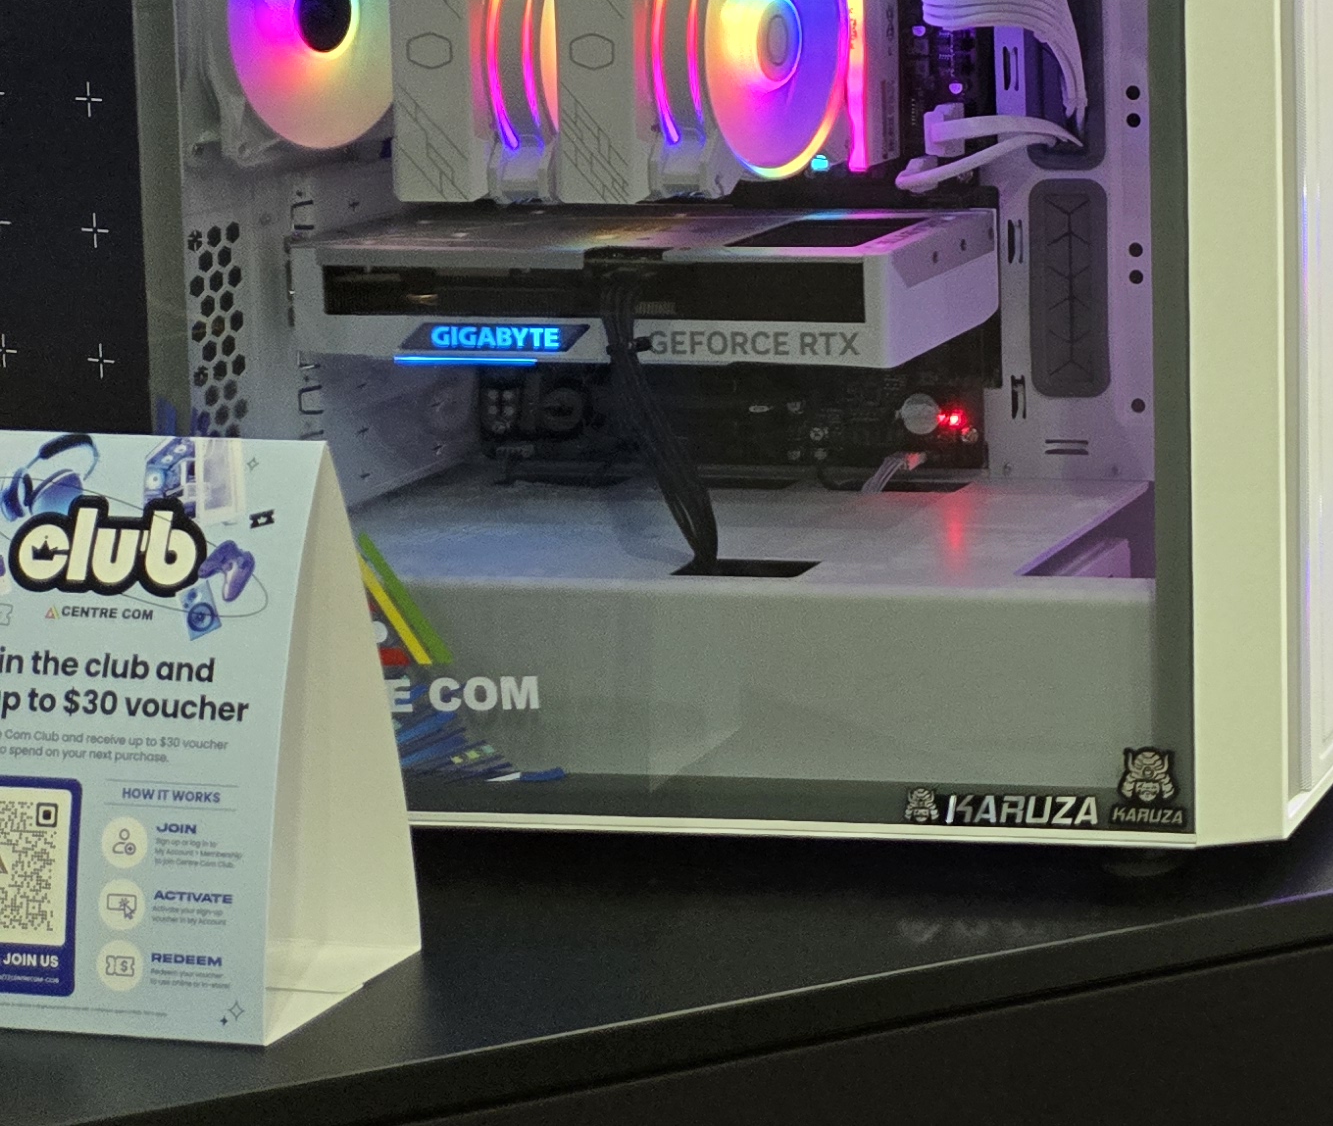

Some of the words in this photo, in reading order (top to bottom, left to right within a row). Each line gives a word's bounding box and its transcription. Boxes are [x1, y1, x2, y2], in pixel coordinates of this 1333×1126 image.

[430, 324, 560, 348] GIGABYTE
[651, 331, 787, 356] GEFORCE
[802, 332, 860, 356] RTX
[18, 506, 198, 587] club
[61, 605, 118, 620] CENTRE
[122, 609, 154, 621] COM
[31, 651, 79, 676] the
[85, 653, 151, 679] club
[156, 657, 216, 683] and
[429, 675, 541, 711] COM
[28, 689, 56, 713] to
[63, 688, 118, 718] $30
[125, 694, 249, 722] voucher
[4, 729, 32, 742] Com
[33, 730, 60, 743] Club
[62, 732, 84, 745] and
[86, 734, 126, 747] receive
[128, 736, 143, 751] up
[145, 736, 157, 748] to
[160, 735, 180, 749] $30
[182, 737, 228, 751] voucher
[9, 744, 43, 758] spend
[45, 746, 60, 758] on
[62, 748, 86, 761] your
[88, 749, 112, 761] next
[114, 749, 170, 764] purchase.
[122, 787, 155, 801] HOW
[157, 789, 169, 802] IT
[172, 790, 221, 805] WORKS
[945, 794, 1099, 825] KARUZA
[1112, 806, 1184, 825] KARUZA
[156, 823, 197, 834] JOIN
[153, 890, 233, 904] ACTIVATE
[2, 952, 38, 968] JOIN
[40, 954, 59, 969] US
[151, 952, 223, 967] REDEEM
